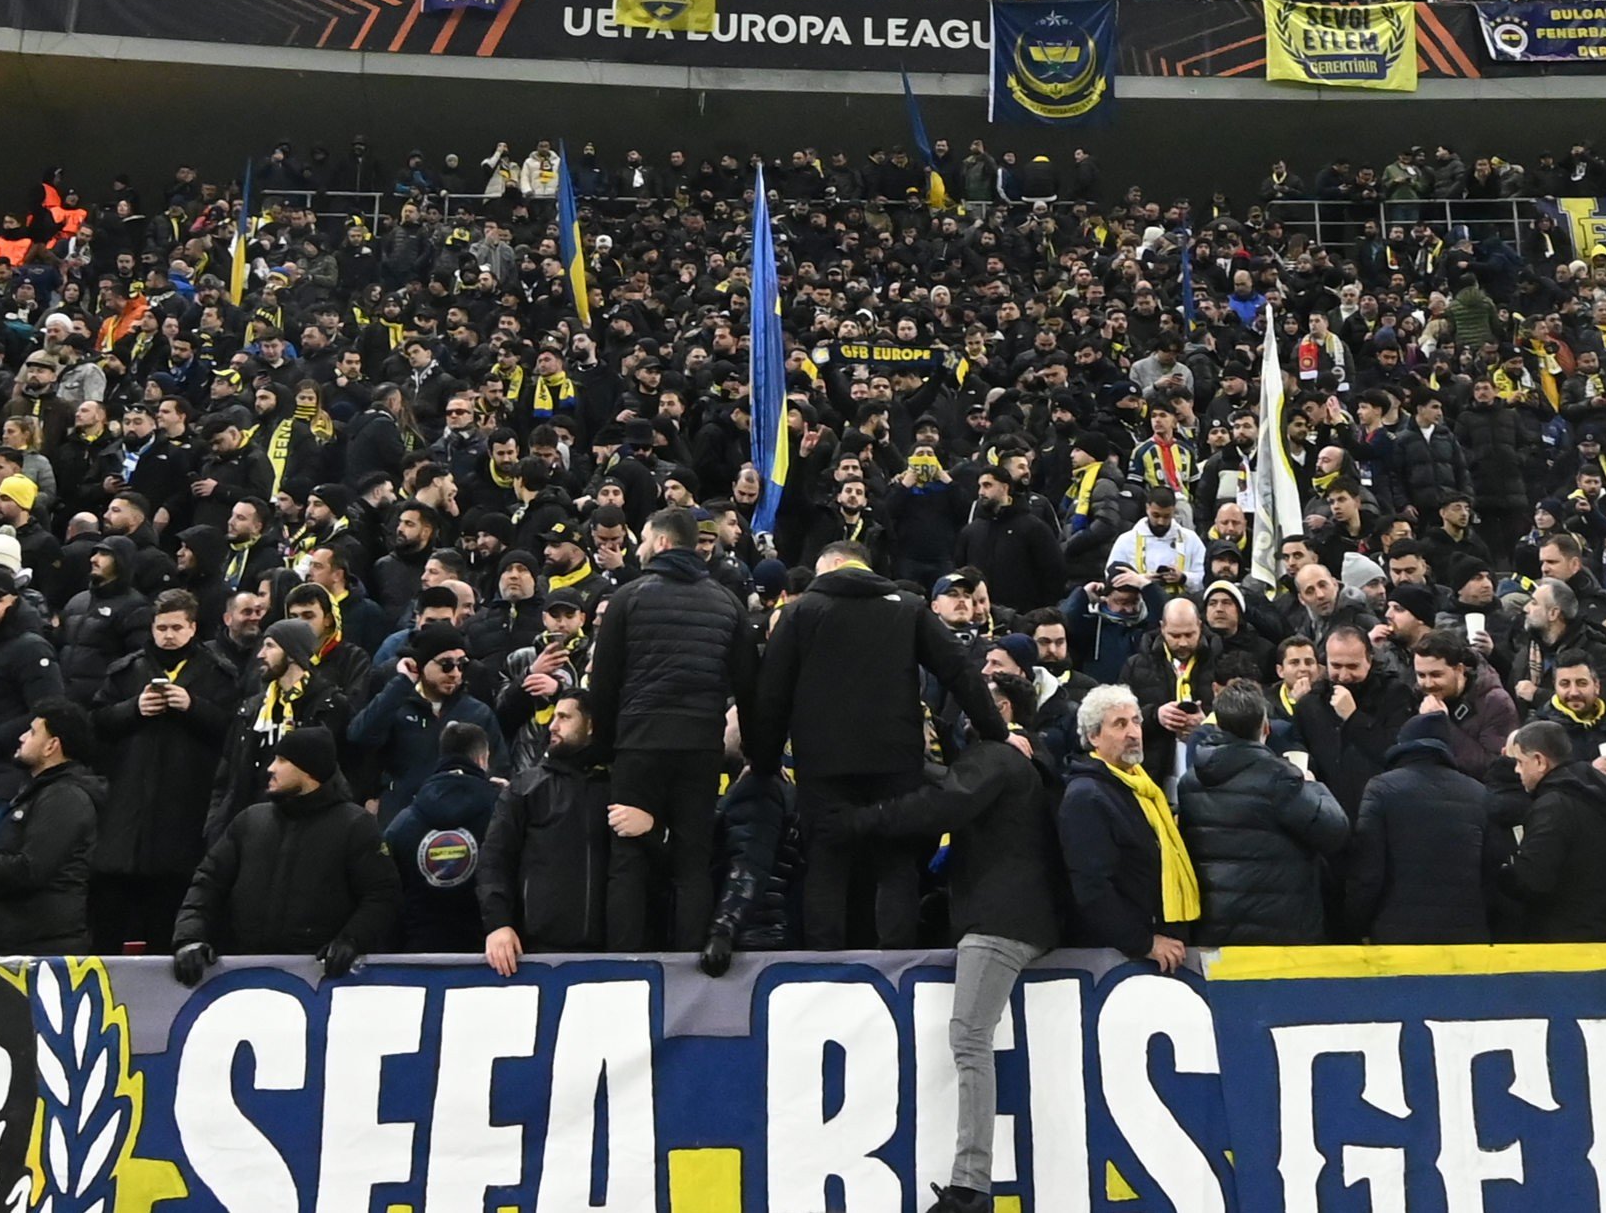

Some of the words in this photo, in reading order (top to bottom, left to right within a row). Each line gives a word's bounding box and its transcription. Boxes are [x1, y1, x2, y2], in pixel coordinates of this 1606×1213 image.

[563, 6, 674, 39] UE
[687, 13, 852, 46] UROPA
[864, 16, 991, 49] LEAGU
[1303, 29, 1379, 52] EYLEM
[840, 344, 869, 359] GFB
[873, 346, 932, 361] EUROPE
